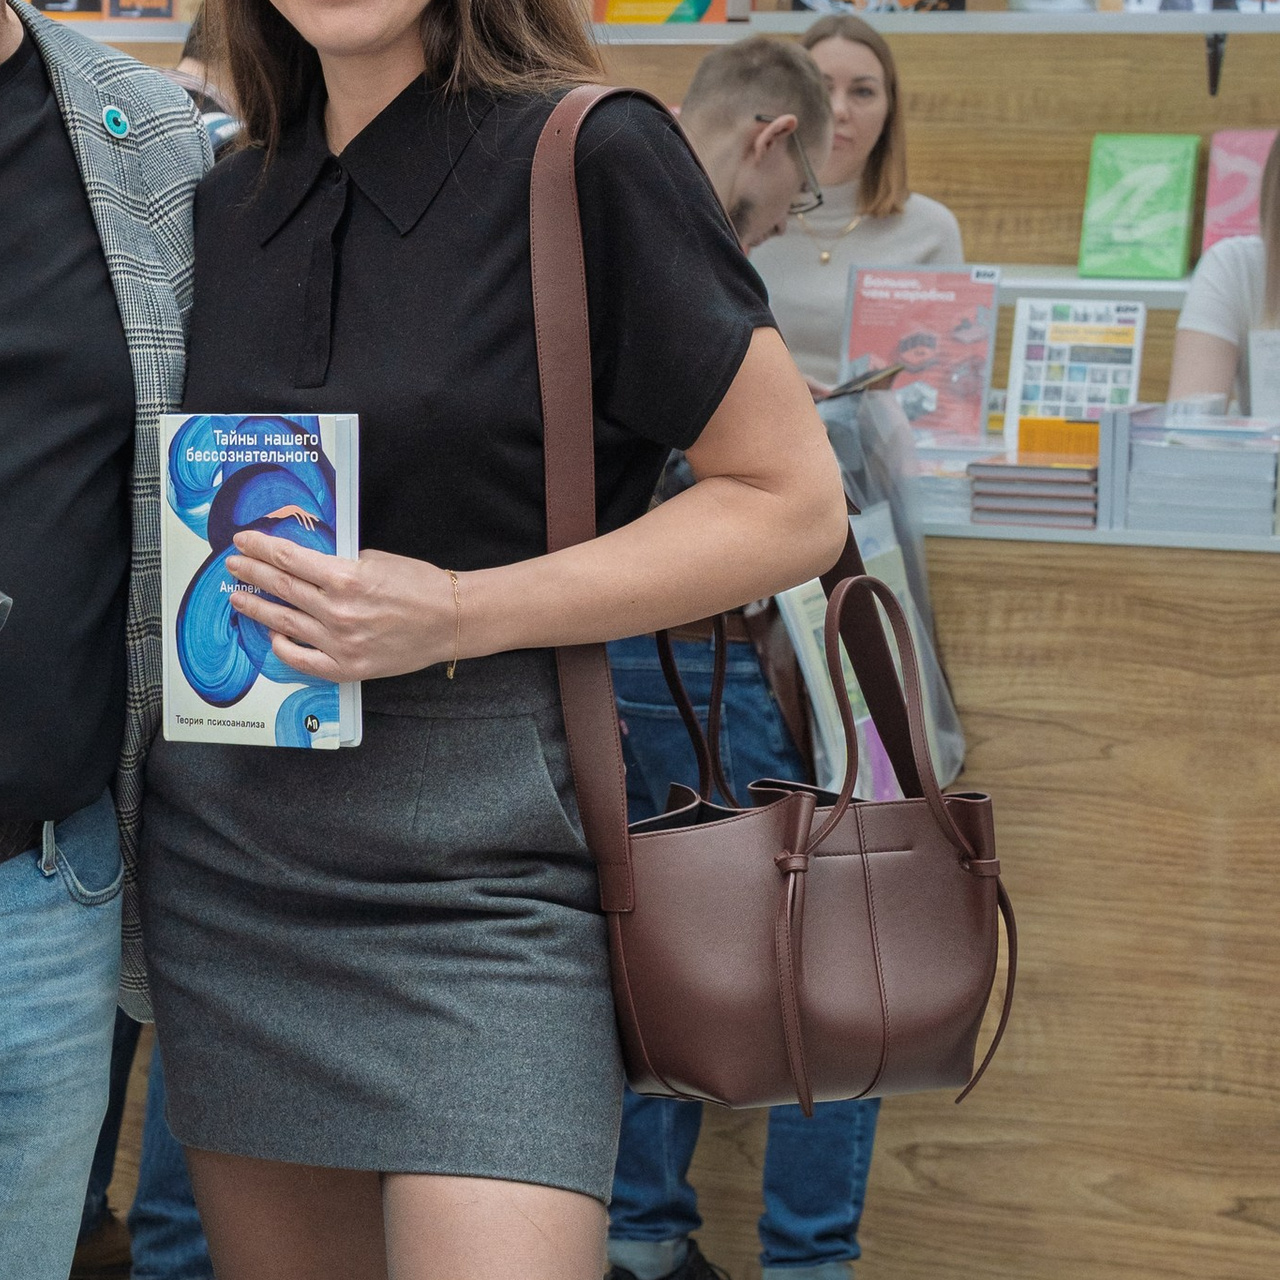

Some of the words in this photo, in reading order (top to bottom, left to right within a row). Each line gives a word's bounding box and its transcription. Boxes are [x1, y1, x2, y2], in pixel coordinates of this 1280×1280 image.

[213, 429, 258, 446] Тайны
[264, 433, 319, 446] нашего
[186, 446, 319, 463] бессознательного
[175, 714, 204, 726] Теория
[206, 718, 266, 729] психоанализа
